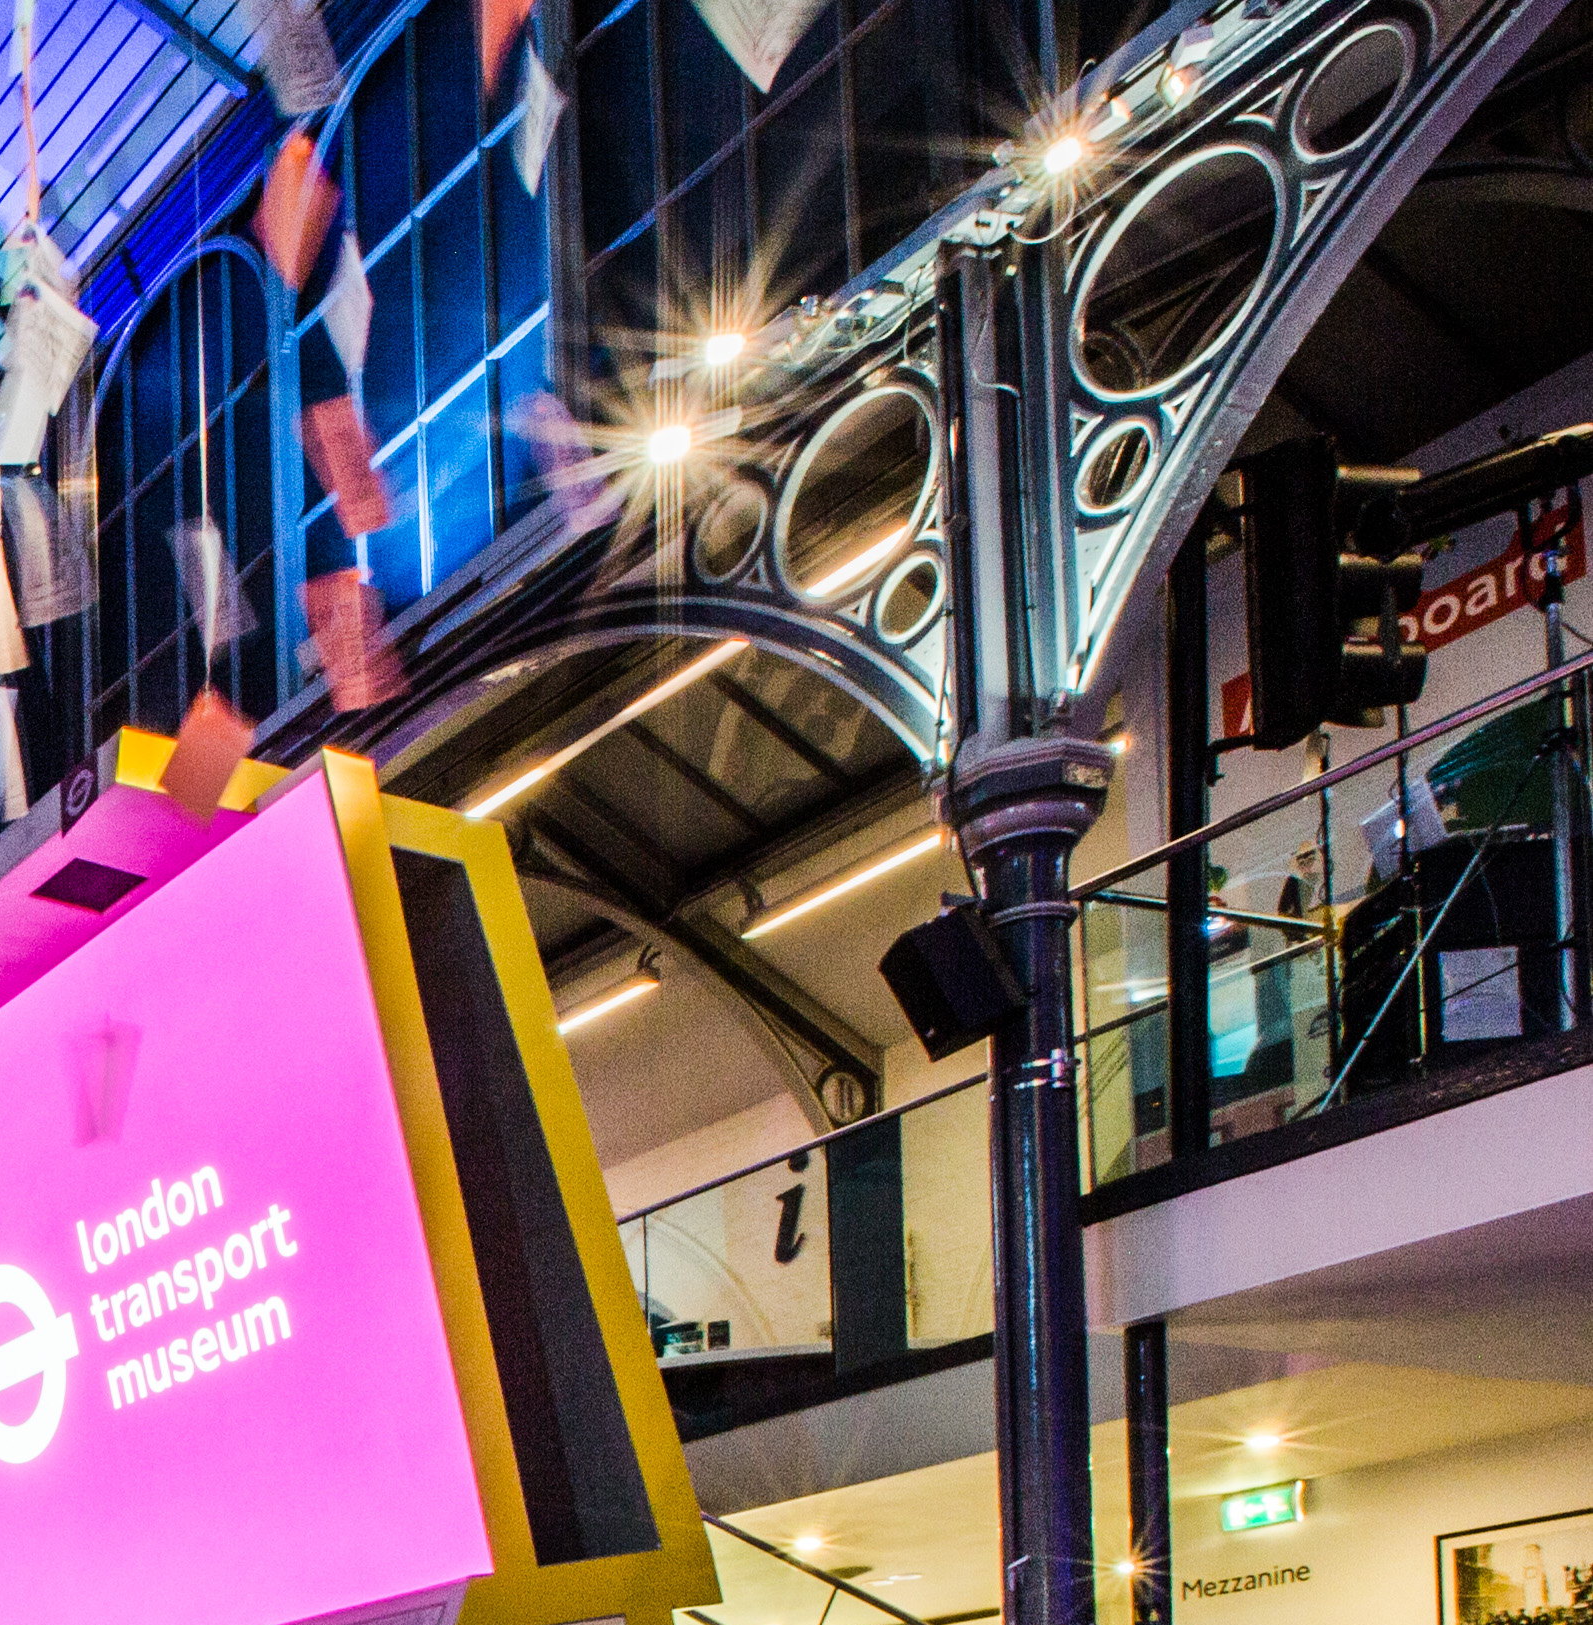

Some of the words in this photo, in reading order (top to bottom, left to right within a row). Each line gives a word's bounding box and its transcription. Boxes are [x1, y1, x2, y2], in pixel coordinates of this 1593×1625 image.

[75, 1164, 224, 1274] london
[88, 1203, 299, 1343] transport
[105, 1294, 292, 1410] museum
[1181, 1560, 1311, 1602] Mezzanine
